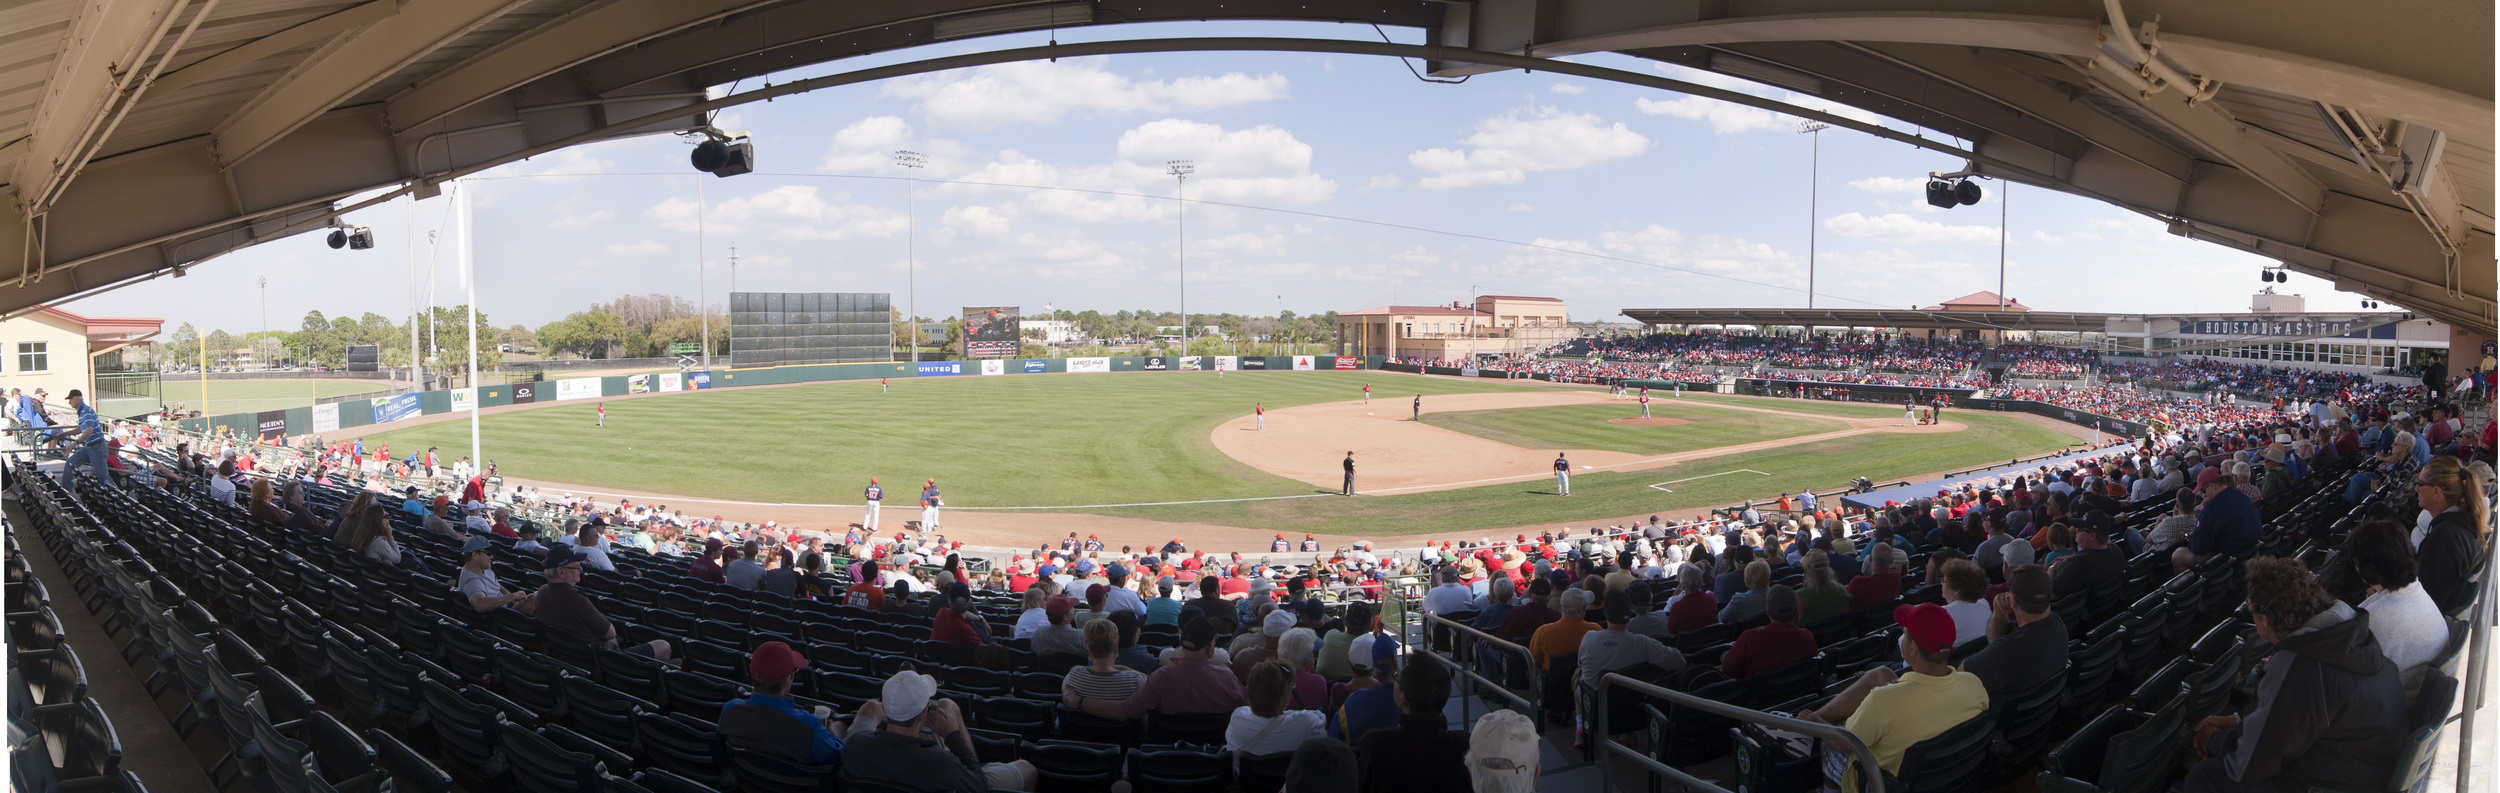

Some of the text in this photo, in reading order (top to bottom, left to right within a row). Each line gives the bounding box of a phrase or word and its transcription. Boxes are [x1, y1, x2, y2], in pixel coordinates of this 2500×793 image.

[2206, 321, 2351, 337] HOUSTON ASTROS
[918, 365, 951, 373] UNITED
[215, 424, 228, 433] 330
[259, 419, 285, 429] MORTON'S
